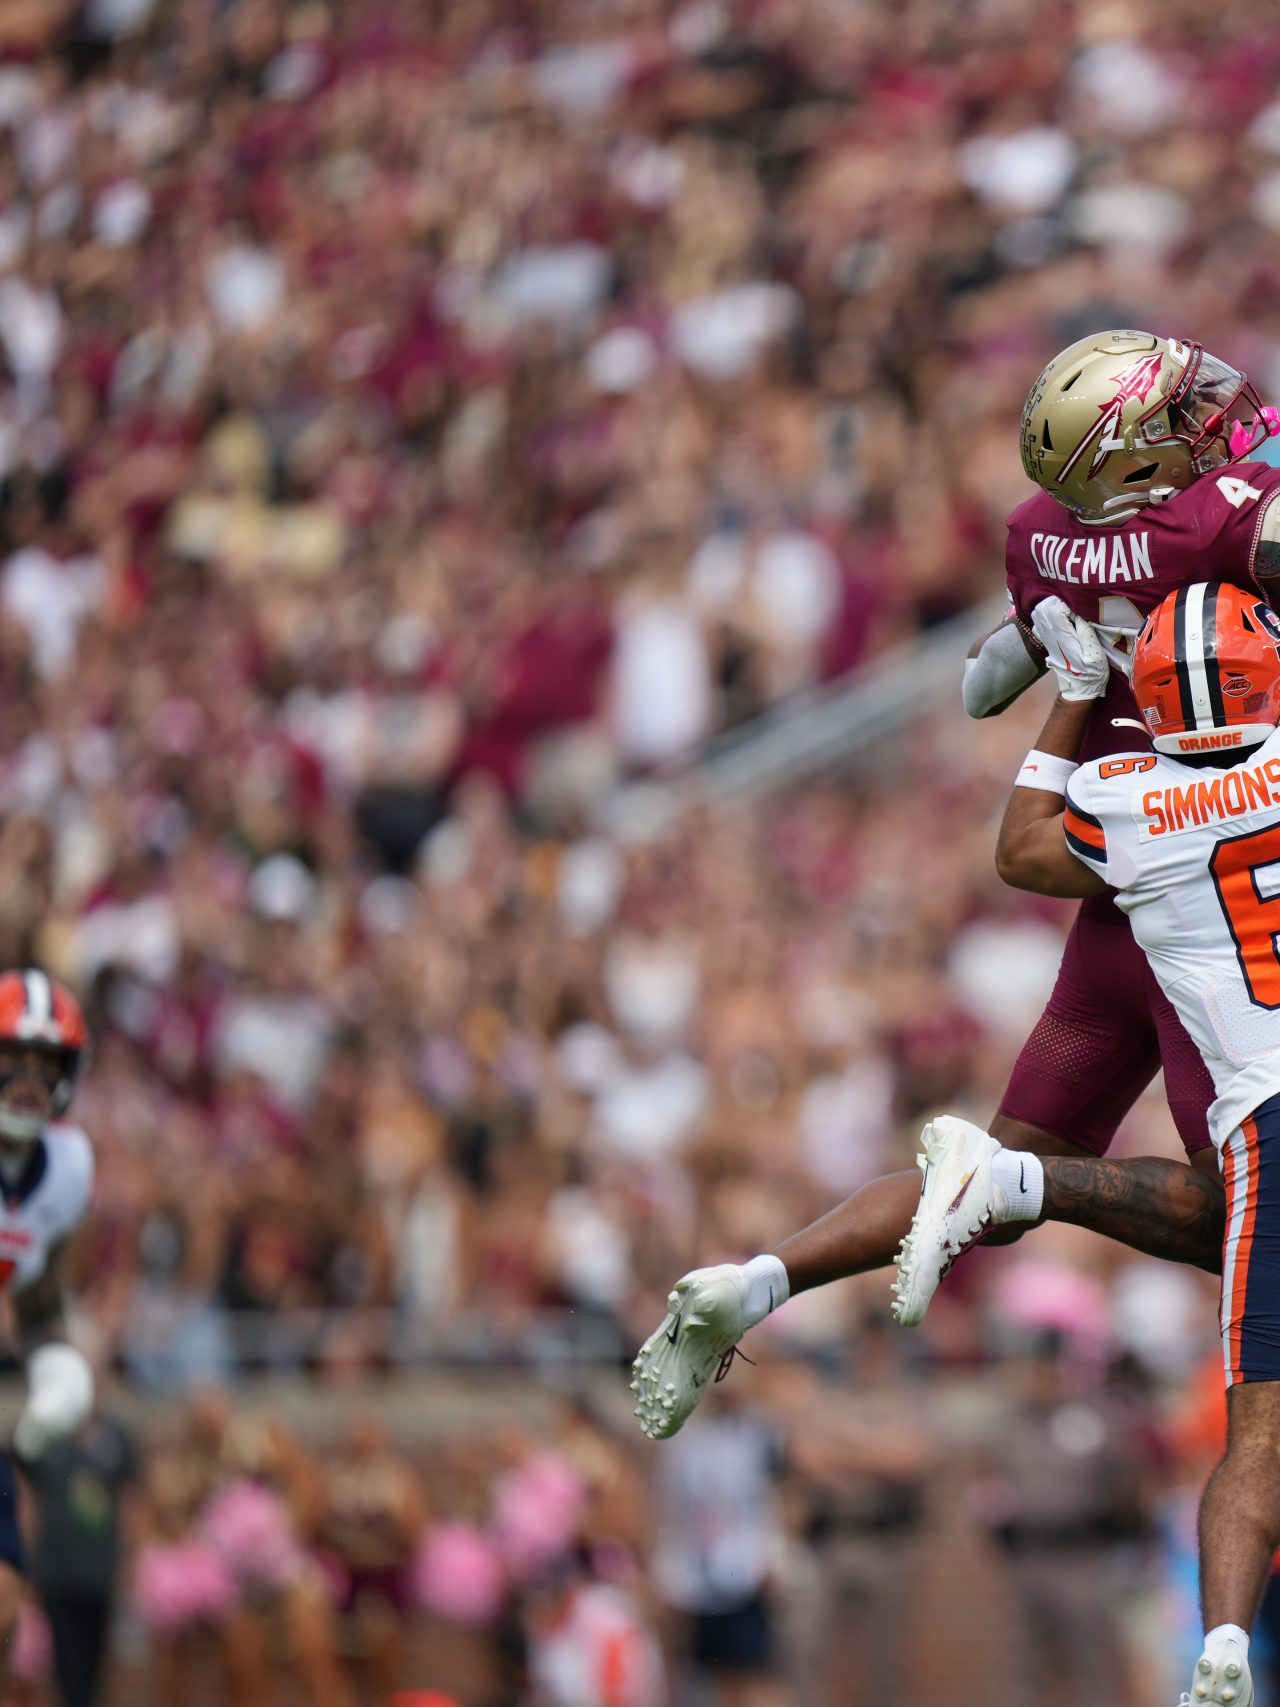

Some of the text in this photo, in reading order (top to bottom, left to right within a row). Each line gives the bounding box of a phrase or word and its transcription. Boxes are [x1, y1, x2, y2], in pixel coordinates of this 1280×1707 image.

[1215, 475, 1264, 510] 4
[1030, 531, 1154, 584] COLEMAN
[1178, 731, 1243, 752] ORANGE
[1098, 756, 1158, 780] 6
